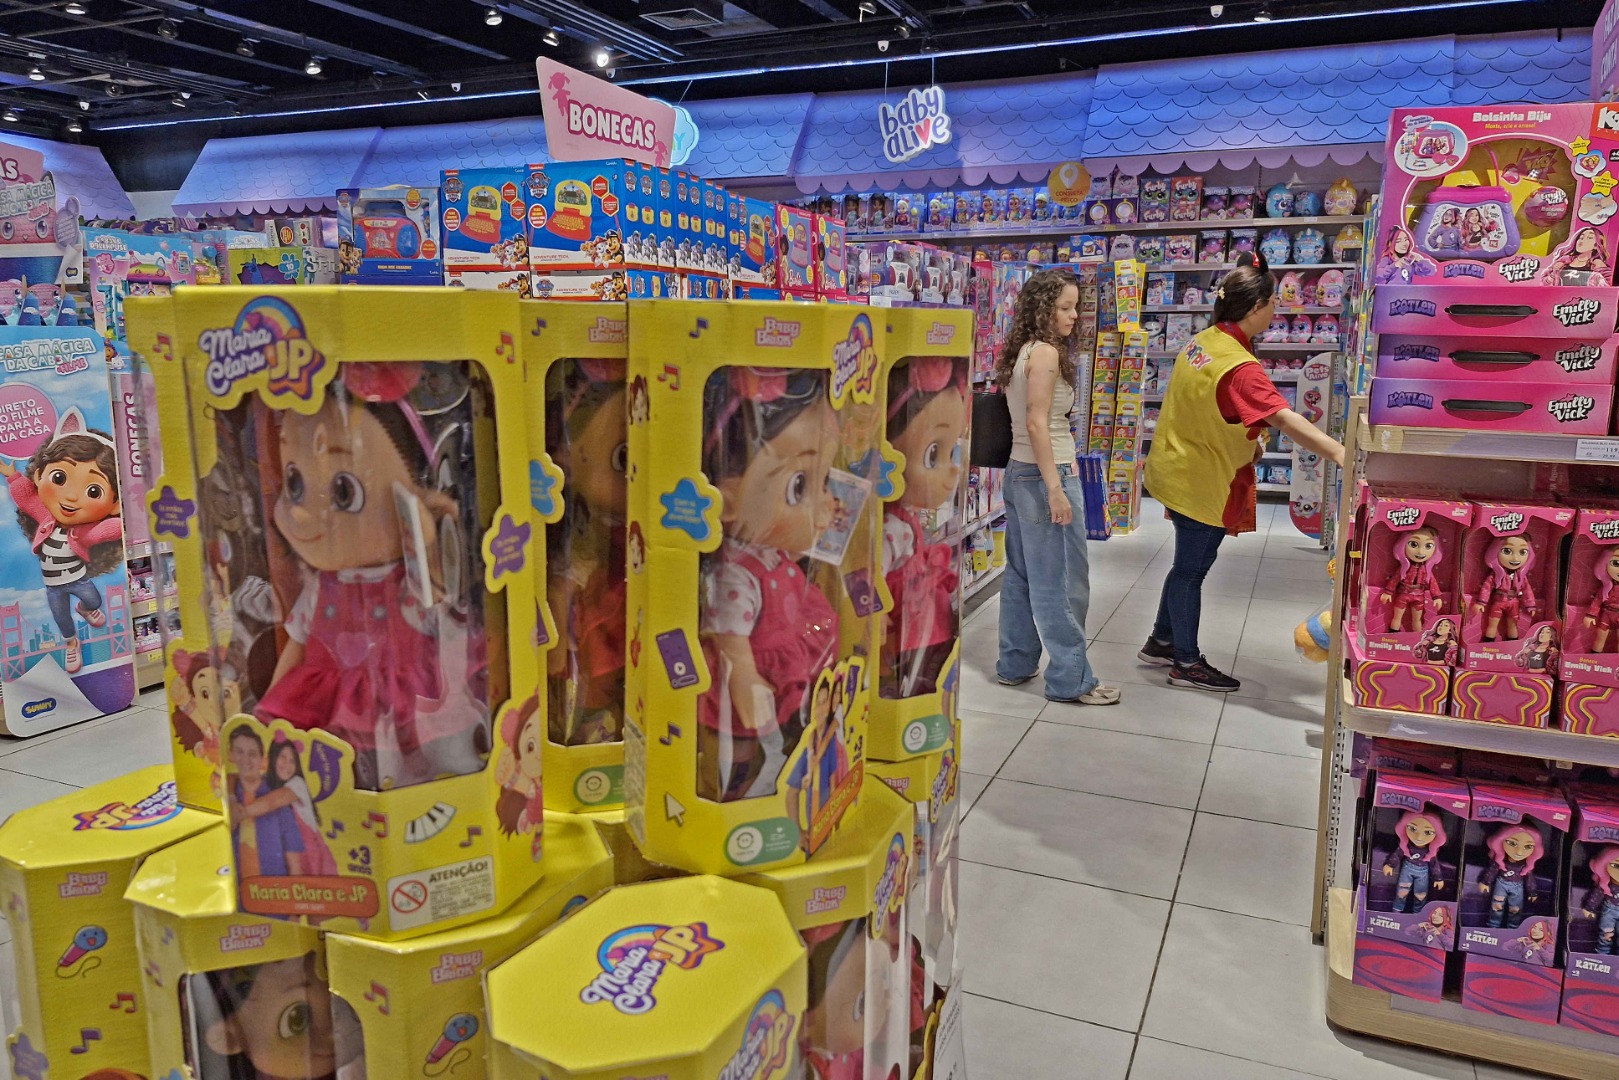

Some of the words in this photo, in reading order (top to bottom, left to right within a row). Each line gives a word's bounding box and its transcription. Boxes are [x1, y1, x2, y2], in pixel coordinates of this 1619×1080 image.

[882, 90, 939, 136] baby
[1472, 112, 1524, 122] Bolsinha
[1528, 111, 1552, 122] Biju
[569, 102, 655, 149] BONECAS
[1145, 181, 1166, 191] Furby
[1176, 180, 1197, 190] Furby
[1170, 239, 1191, 249] Furby
[1499, 258, 1539, 274] Emilly
[1504, 268, 1533, 282] Vick
[1554, 298, 1600, 316] Emilly
[1561, 312, 1592, 326] Vick
[39, 339, 93, 354] MÁGICA
[200, 328, 272, 360] Maria
[270, 339, 313, 380] JP
[1555, 344, 1602, 362] Emilly
[7, 358, 27, 370] DA
[28, 354, 72, 368] GABBY
[1562, 358, 1594, 372] Vick
[206, 351, 266, 396] Clara
[1306, 364, 1330, 376] Pets
[1548, 395, 1594, 412] Emilly
[11, 406, 44, 420] FILME
[1556, 408, 1588, 422] Vick
[0, 420, 31, 434] PARA
[34, 417, 42, 426] A
[0, 432, 18, 443] UA
[19, 424, 52, 438] CASA
[1387, 507, 1420, 522] Emilly
[1393, 516, 1416, 526] Vick
[1491, 512, 1523, 526] Emilly
[1496, 520, 1519, 532] Vick
[1590, 520, 1619, 533] Emill
[1368, 642, 1392, 650] Emilly
[1470, 652, 1494, 660] Emilly
[1564, 662, 1592, 672] Emilly
[1594, 665, 1612, 673] Vick
[348, 846, 371, 865] +3
[429, 861, 488, 882] ATENÇÃO!
[250, 884, 288, 900] Maria
[292, 884, 334, 902] Clara
[350, 885, 366, 902] JP
[654, 925, 698, 964] JP
[581, 947, 646, 1004] Maria
[614, 961, 662, 1014] Clara
